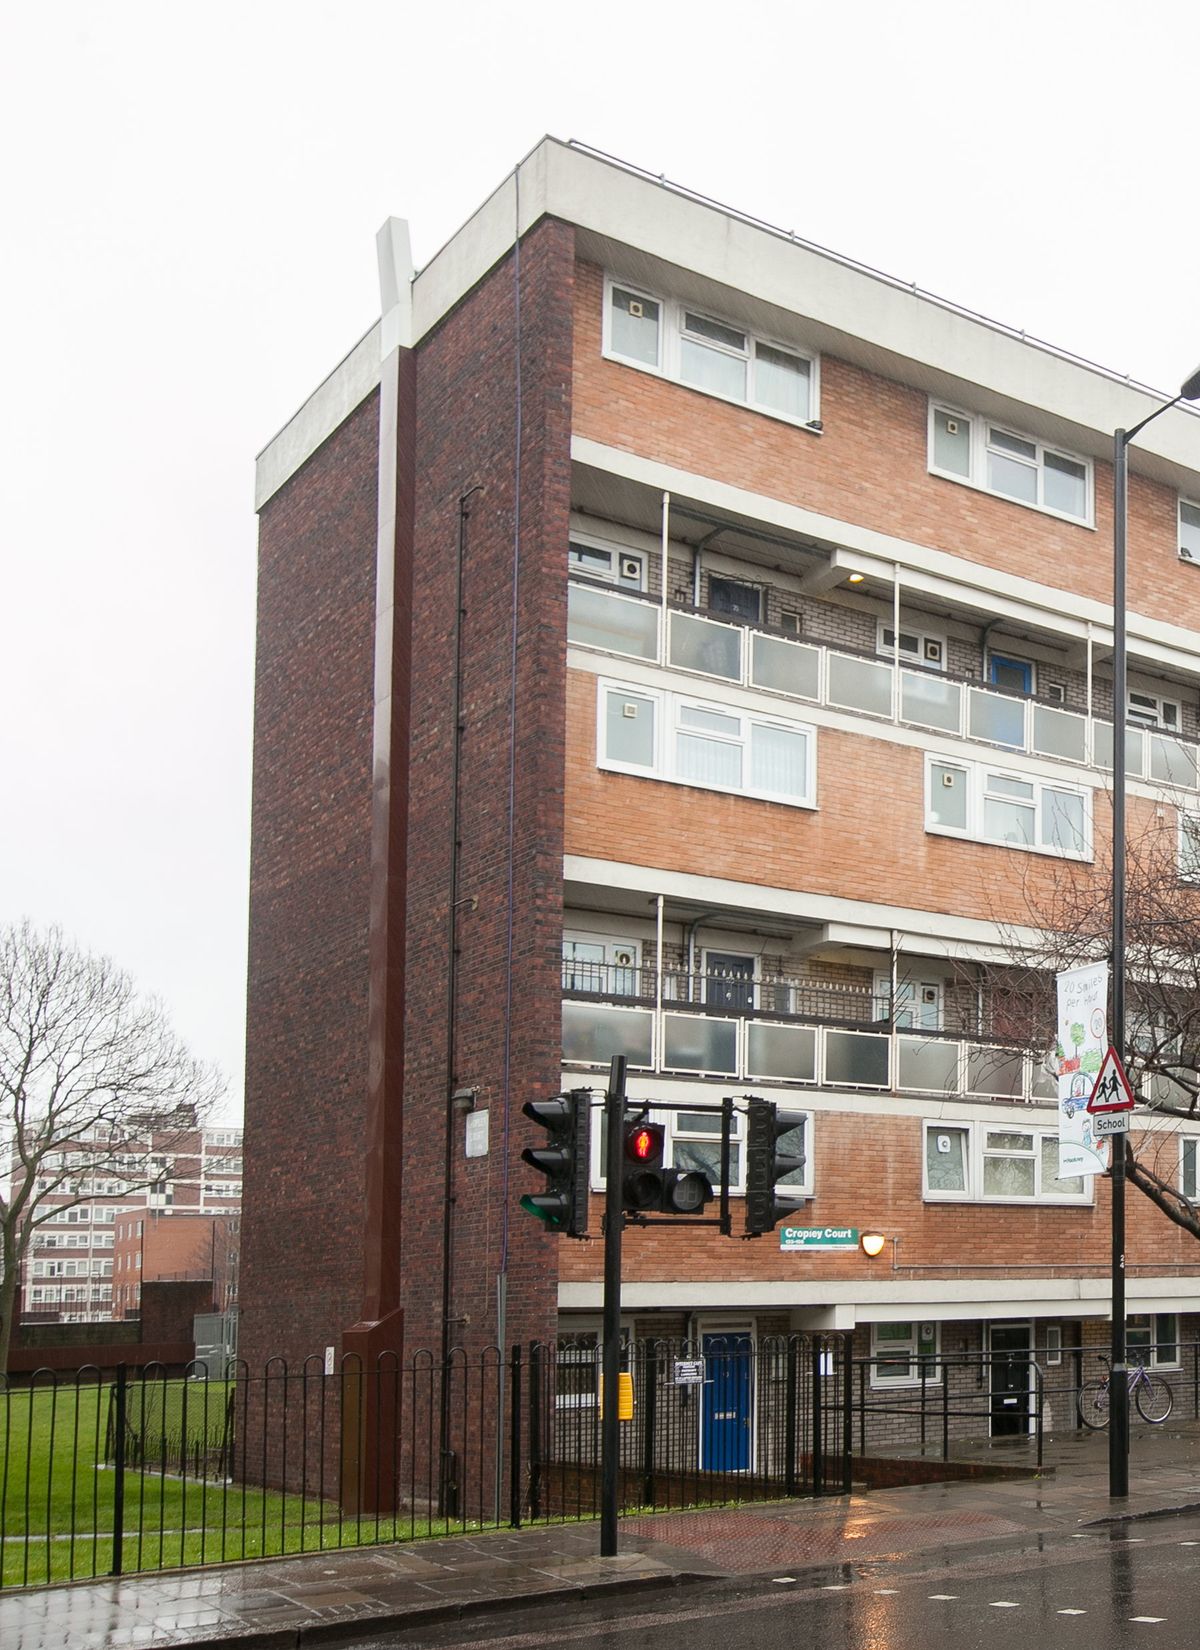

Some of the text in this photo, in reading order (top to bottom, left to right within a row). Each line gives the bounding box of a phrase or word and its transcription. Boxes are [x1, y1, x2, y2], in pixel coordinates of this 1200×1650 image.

[1097, 1116, 1125, 1130] School
[785, 1228, 852, 1240] Cropley Court
